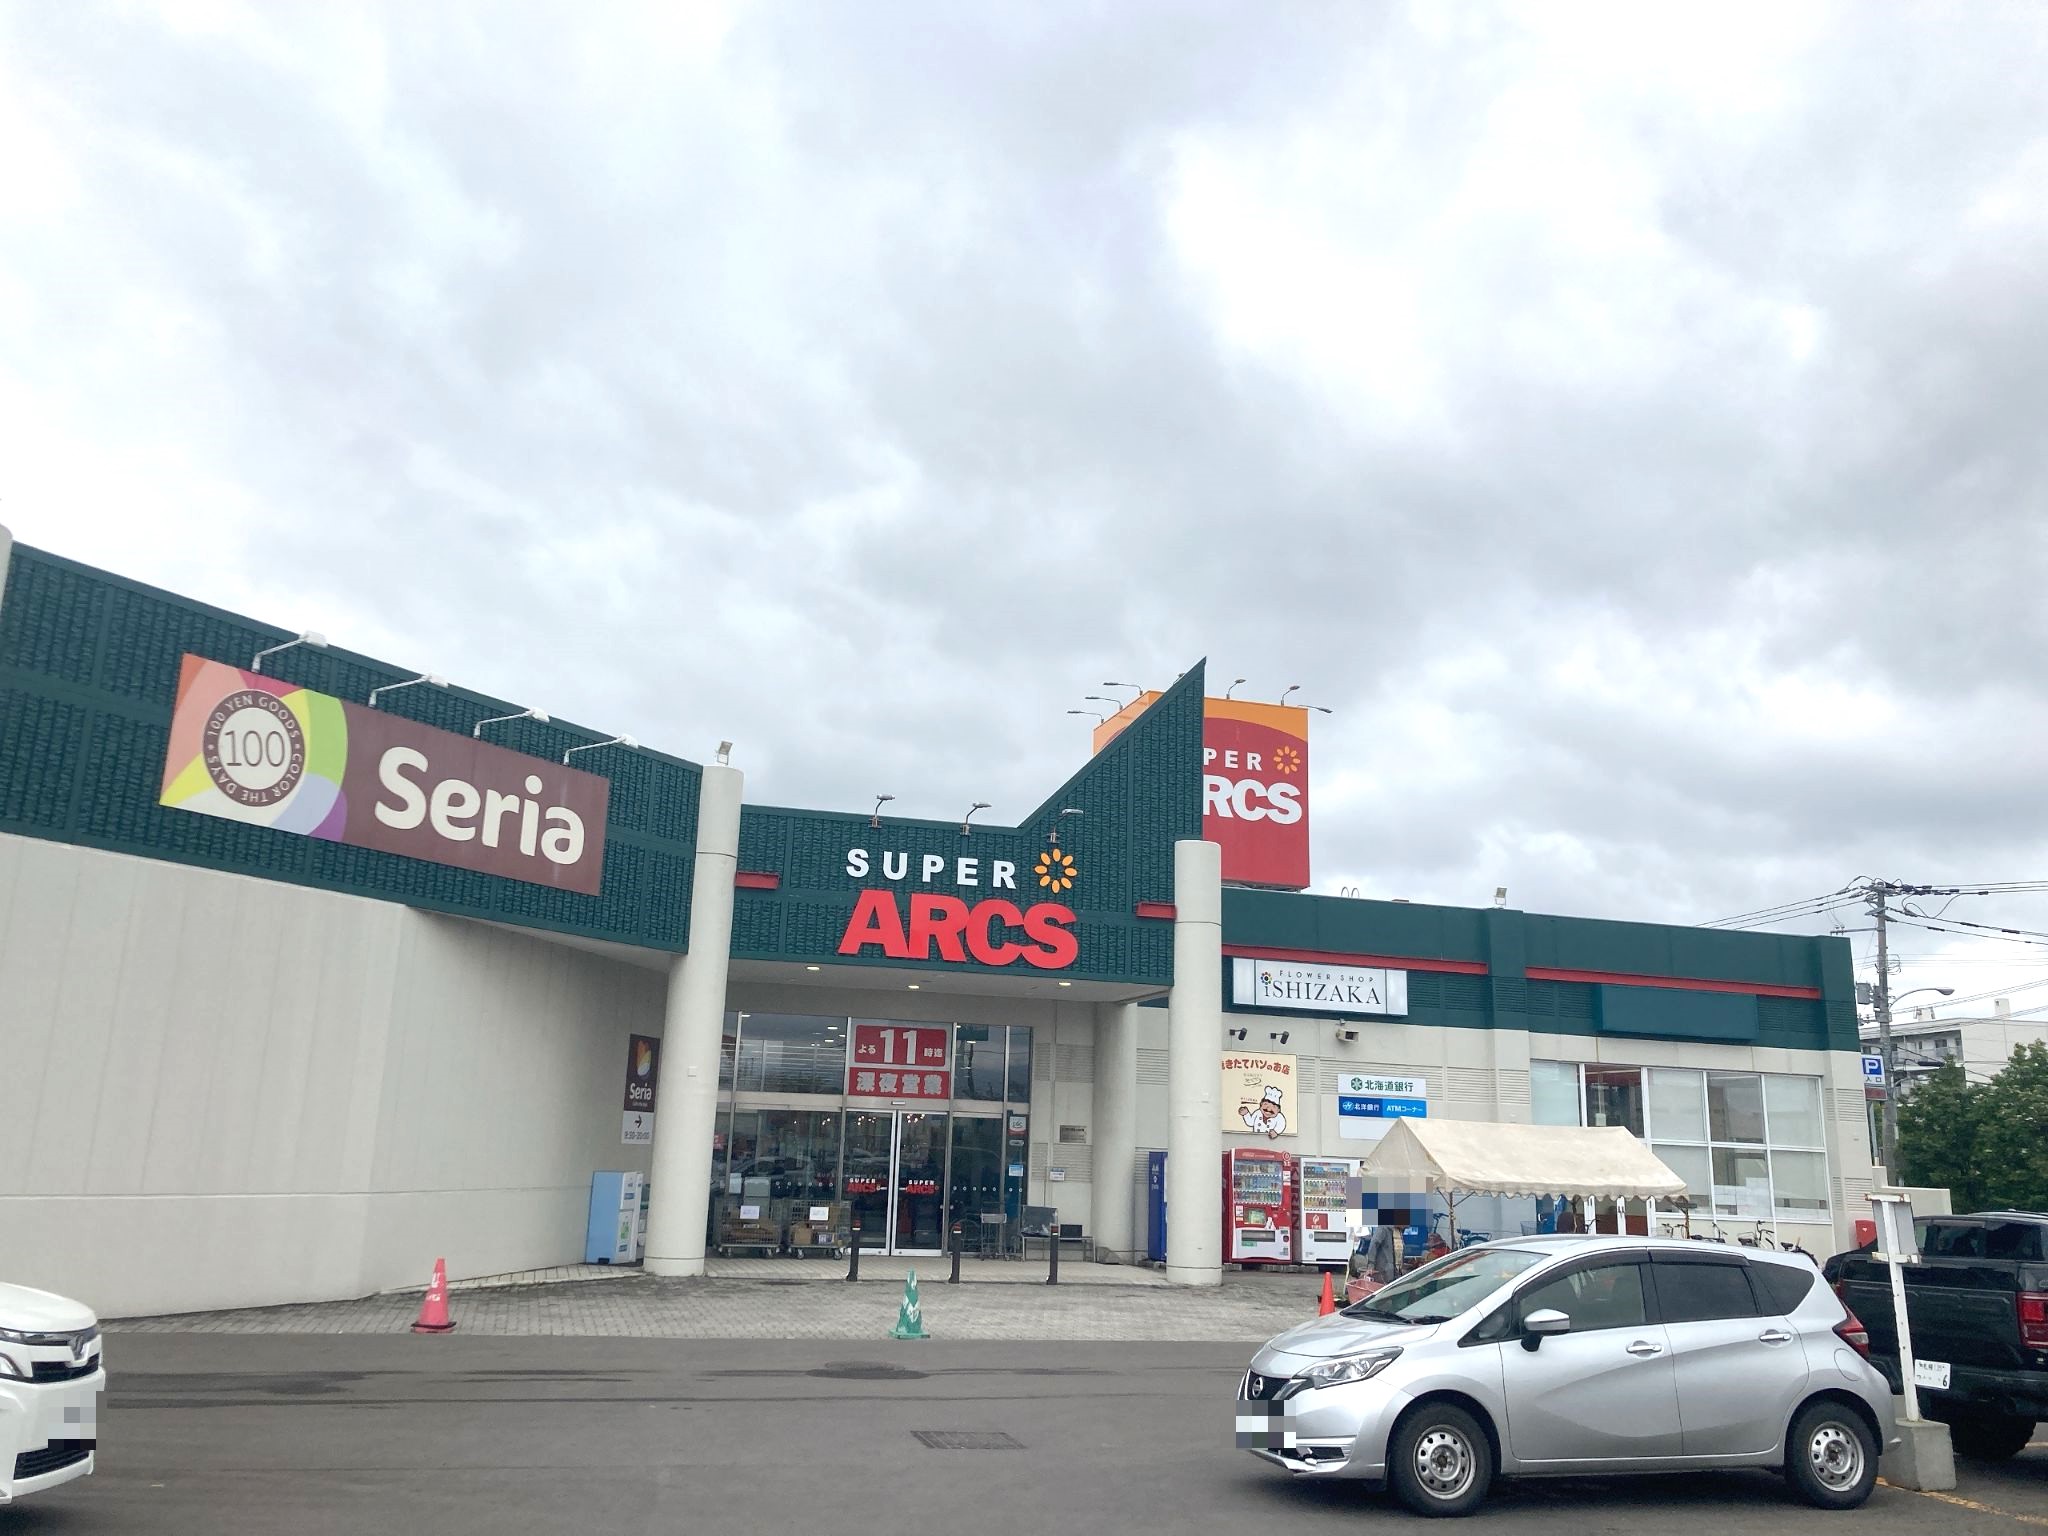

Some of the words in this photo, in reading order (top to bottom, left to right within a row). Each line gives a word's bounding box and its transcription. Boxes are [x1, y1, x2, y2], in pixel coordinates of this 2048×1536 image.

[206, 711, 226, 736] 100
[225, 695, 253, 711] YEN
[258, 696, 300, 738] GOODS
[224, 730, 285, 767] 100
[207, 755, 238, 794] DAYS
[271, 753, 303, 797] COLOR
[240, 790, 269, 802] THE
[374, 746, 585, 865] Seria
[1203, 774, 1303, 824] RCS
[846, 848, 1016, 889] SUPER
[837, 888, 1079, 969] ARCS
[1279, 969, 1331, 980] FLOWER
[1340, 974, 1374, 983] SHOP
[856, 1071, 943, 1096] 深夜営業
[1865, 1059, 1879, 1074] P
[629, 1082, 652, 1100] Seria
[1364, 1079, 1414, 1093] 北海道銀行
[1354, 1102, 1380, 1111] 北洋銀行
[1386, 1104, 1424, 1113] ATMコーナー
